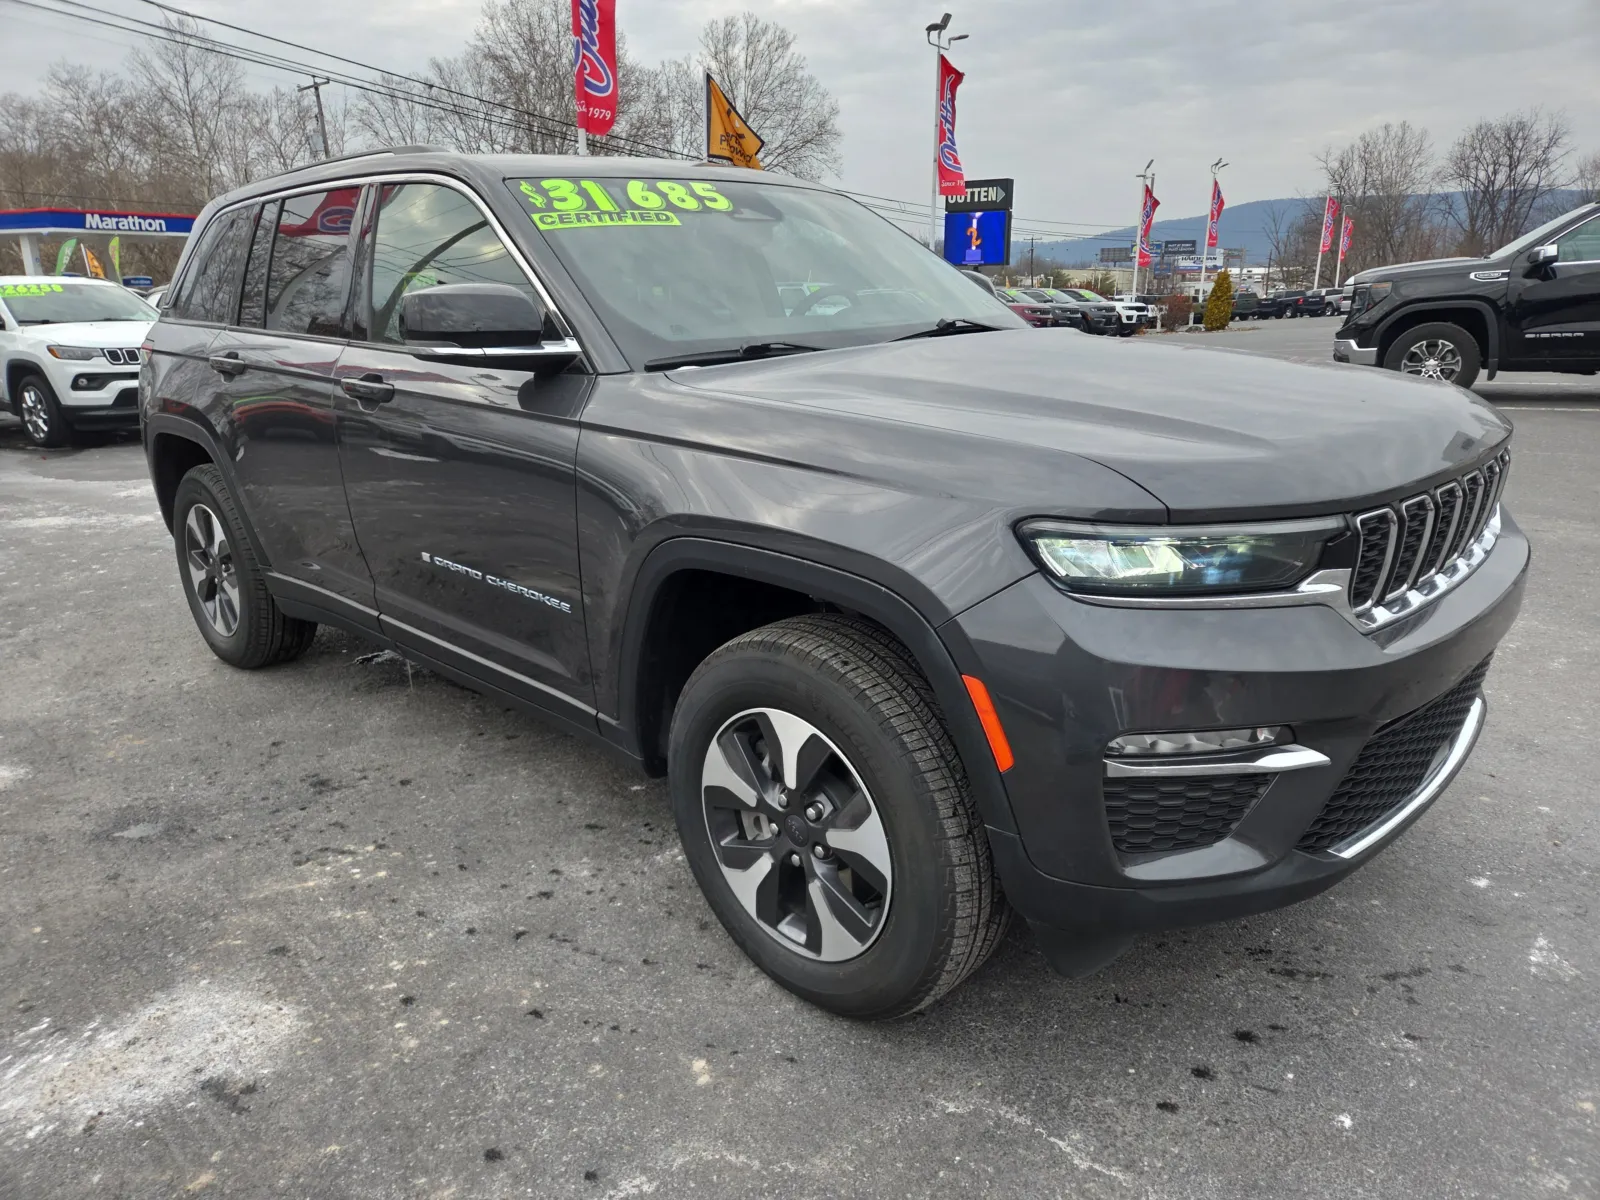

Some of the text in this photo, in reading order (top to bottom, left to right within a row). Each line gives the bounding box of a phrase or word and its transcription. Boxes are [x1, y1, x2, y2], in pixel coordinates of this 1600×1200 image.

[588, 107, 611, 121] 1979
[85, 213, 167, 232] Marathon
[538, 211, 674, 226] CERTIFIED
[433, 556, 572, 614] GRAND CHEROKEE
